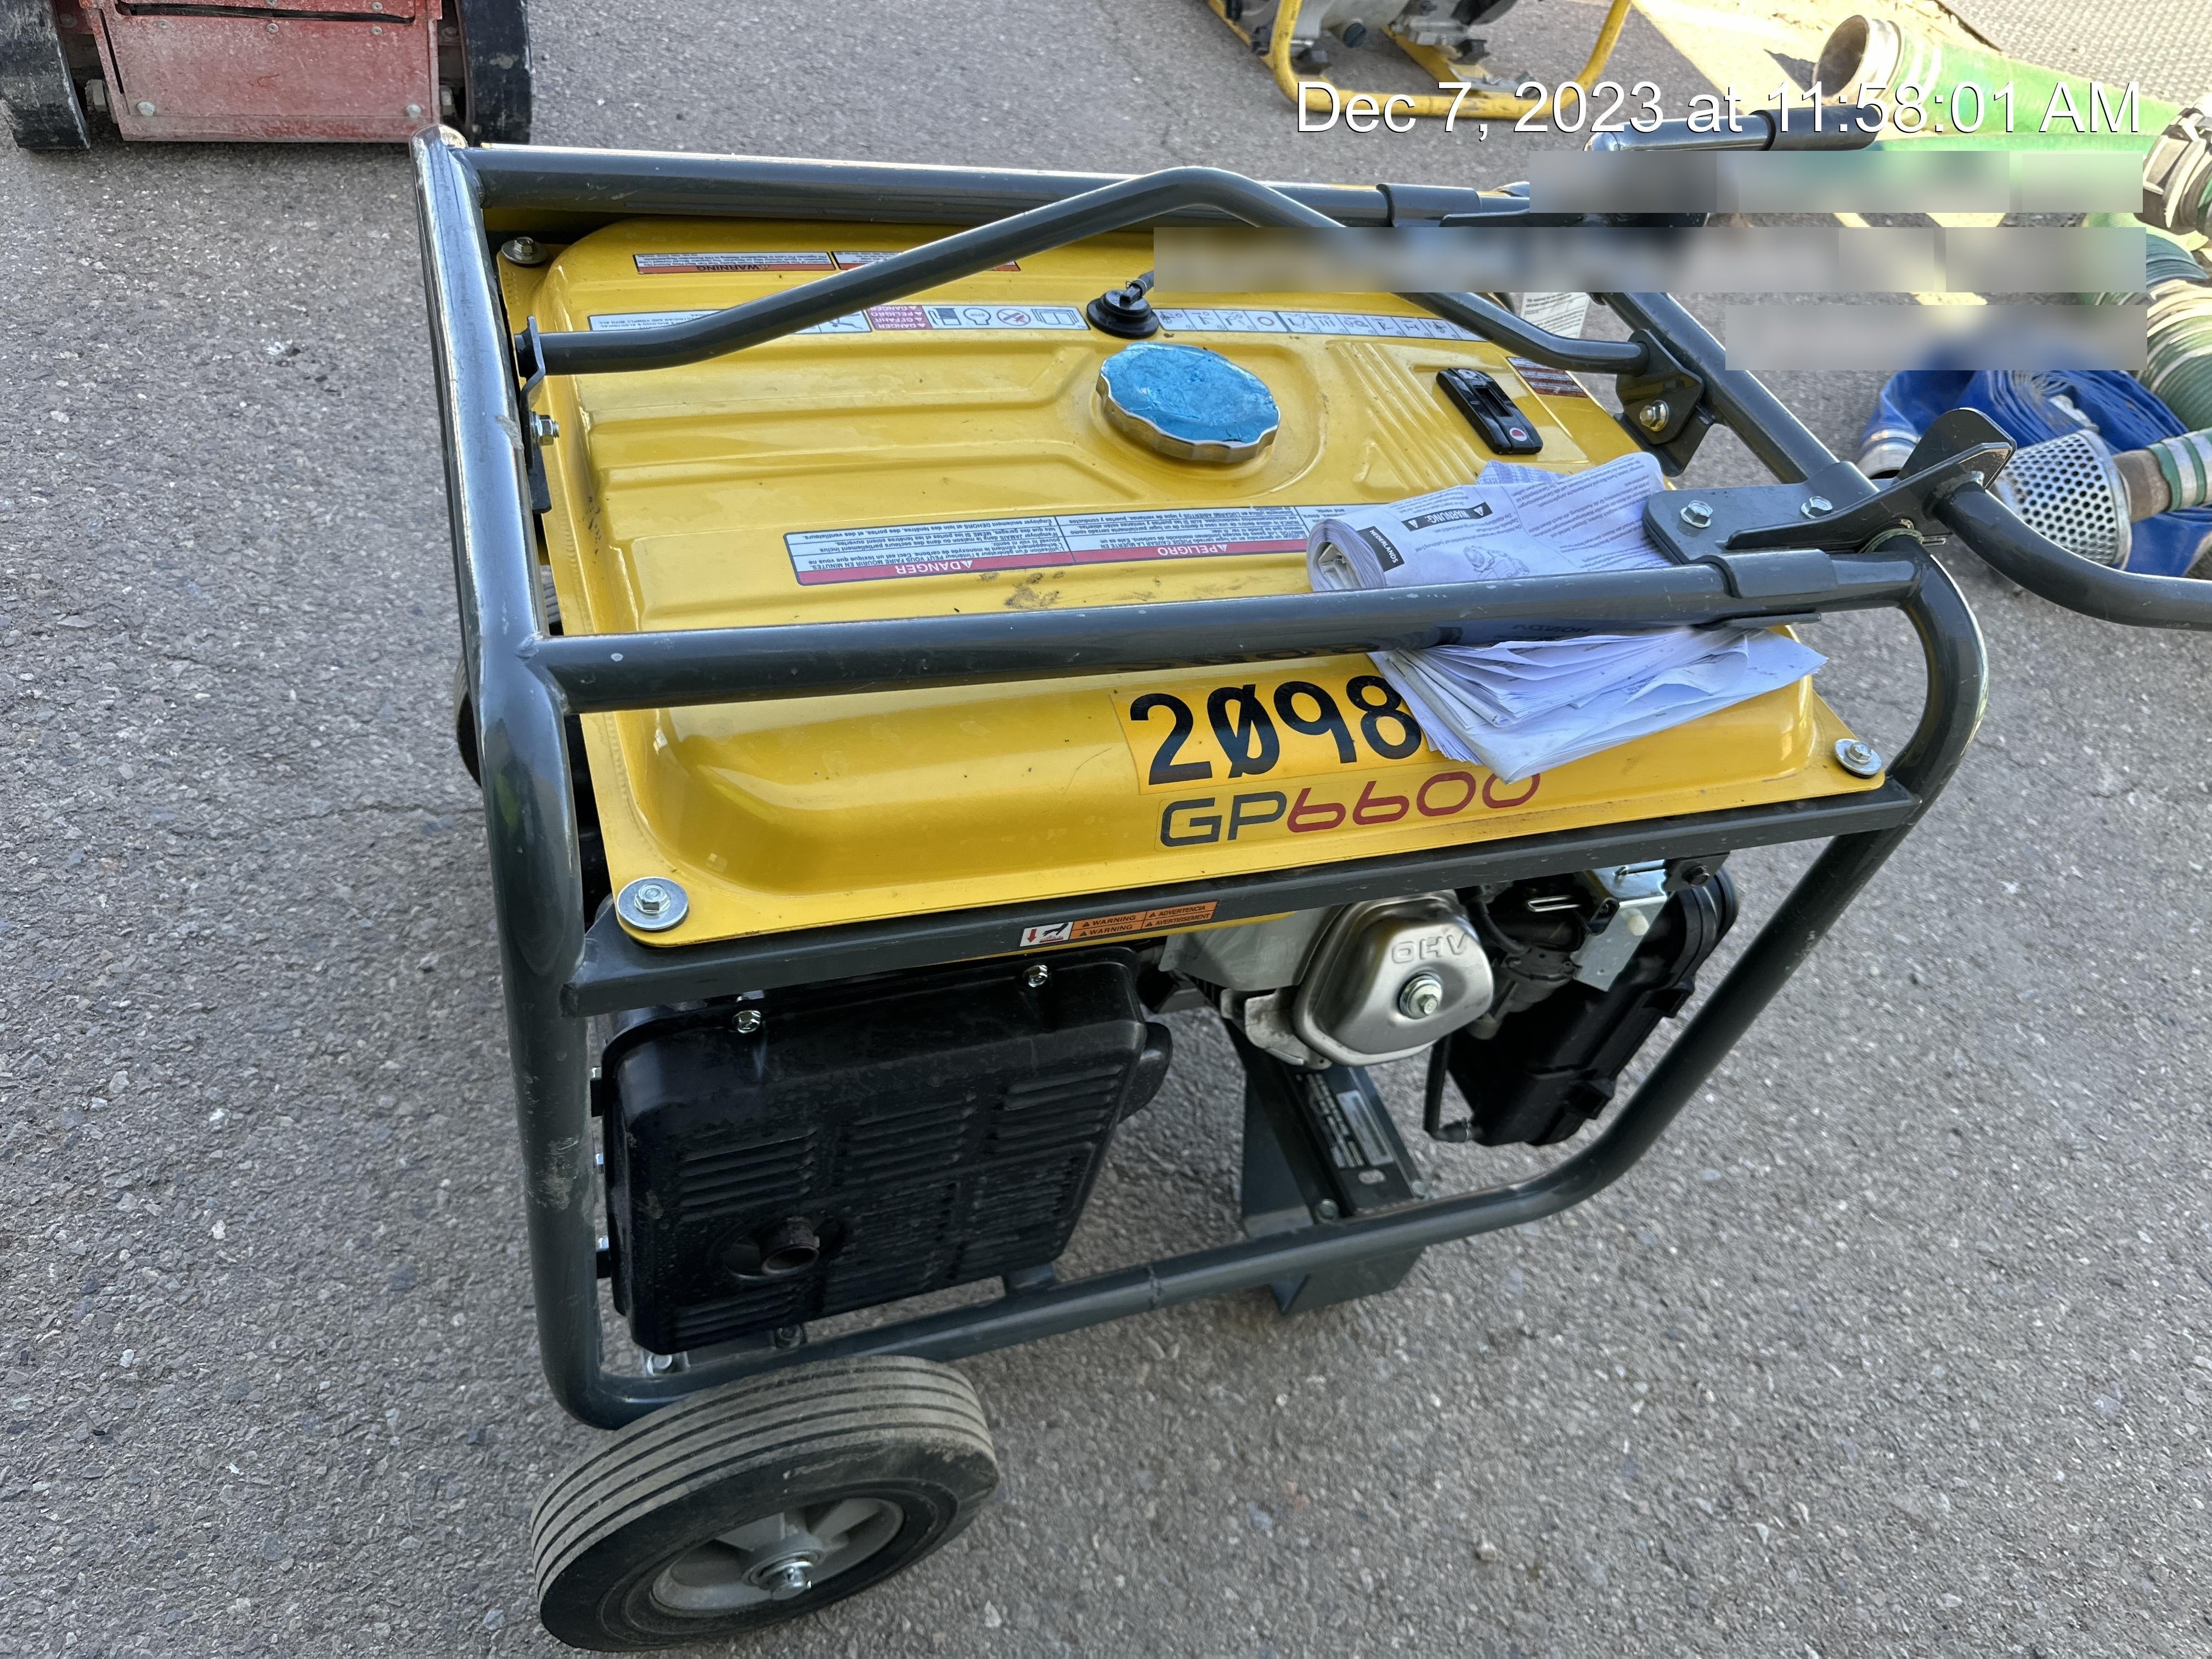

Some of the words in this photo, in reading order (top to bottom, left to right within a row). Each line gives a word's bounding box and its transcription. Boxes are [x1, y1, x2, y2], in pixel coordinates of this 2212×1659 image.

[1424, 507, 1471, 523] WARNUNG:
[840, 543, 883, 551] partiellement
[1155, 544, 1218, 555] PELIGRO
[1369, 529, 1399, 564] NEDERLANDS
[894, 561, 961, 574] DANGER
[1161, 771, 1540, 847] GP6600
[1089, 924, 1133, 935] WARNING
[1154, 913, 1211, 926] AVERTISSEMENT
[1092, 915, 1136, 926] WARNING
[1159, 905, 1206, 917] ADVERTENCIA
[1391, 931, 1470, 964] OHV
